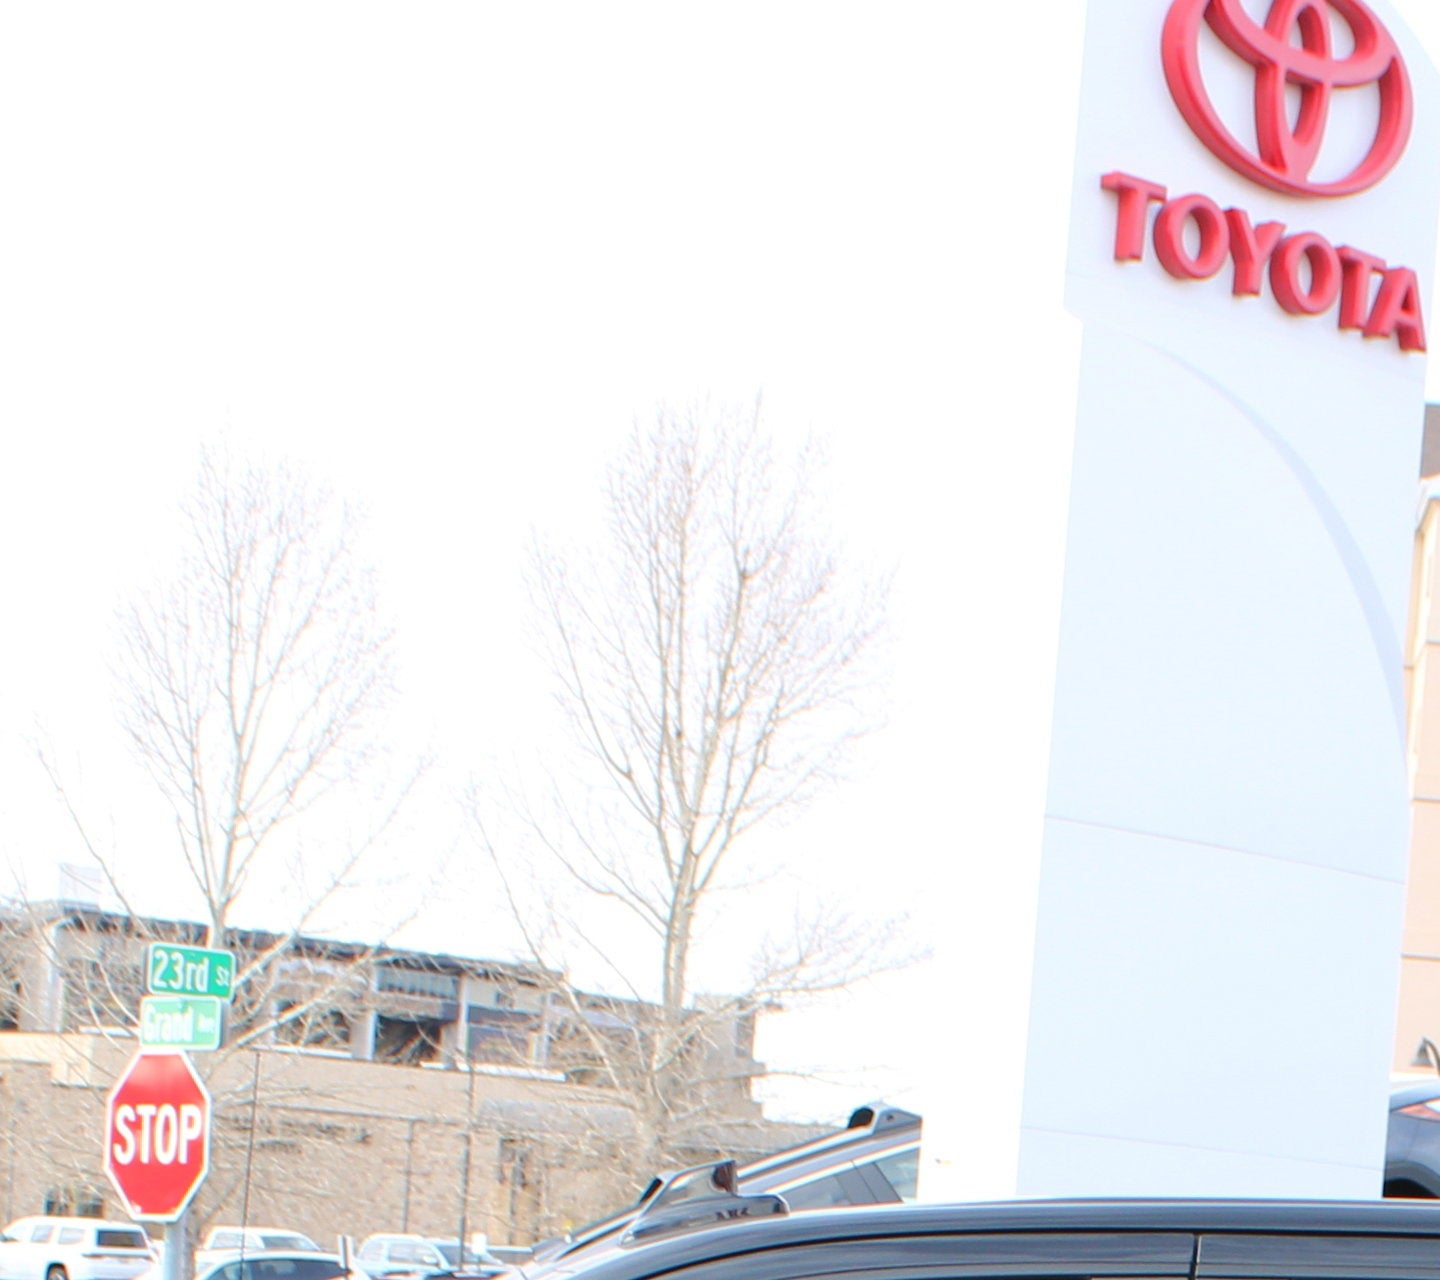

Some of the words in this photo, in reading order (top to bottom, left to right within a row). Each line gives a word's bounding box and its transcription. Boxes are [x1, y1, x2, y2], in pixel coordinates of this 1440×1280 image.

[1100, 170, 1427, 353] TOYOTA
[152, 949, 210, 993] 23rd
[143, 1003, 195, 1043] Grand
[112, 1103, 203, 1166] STOP
